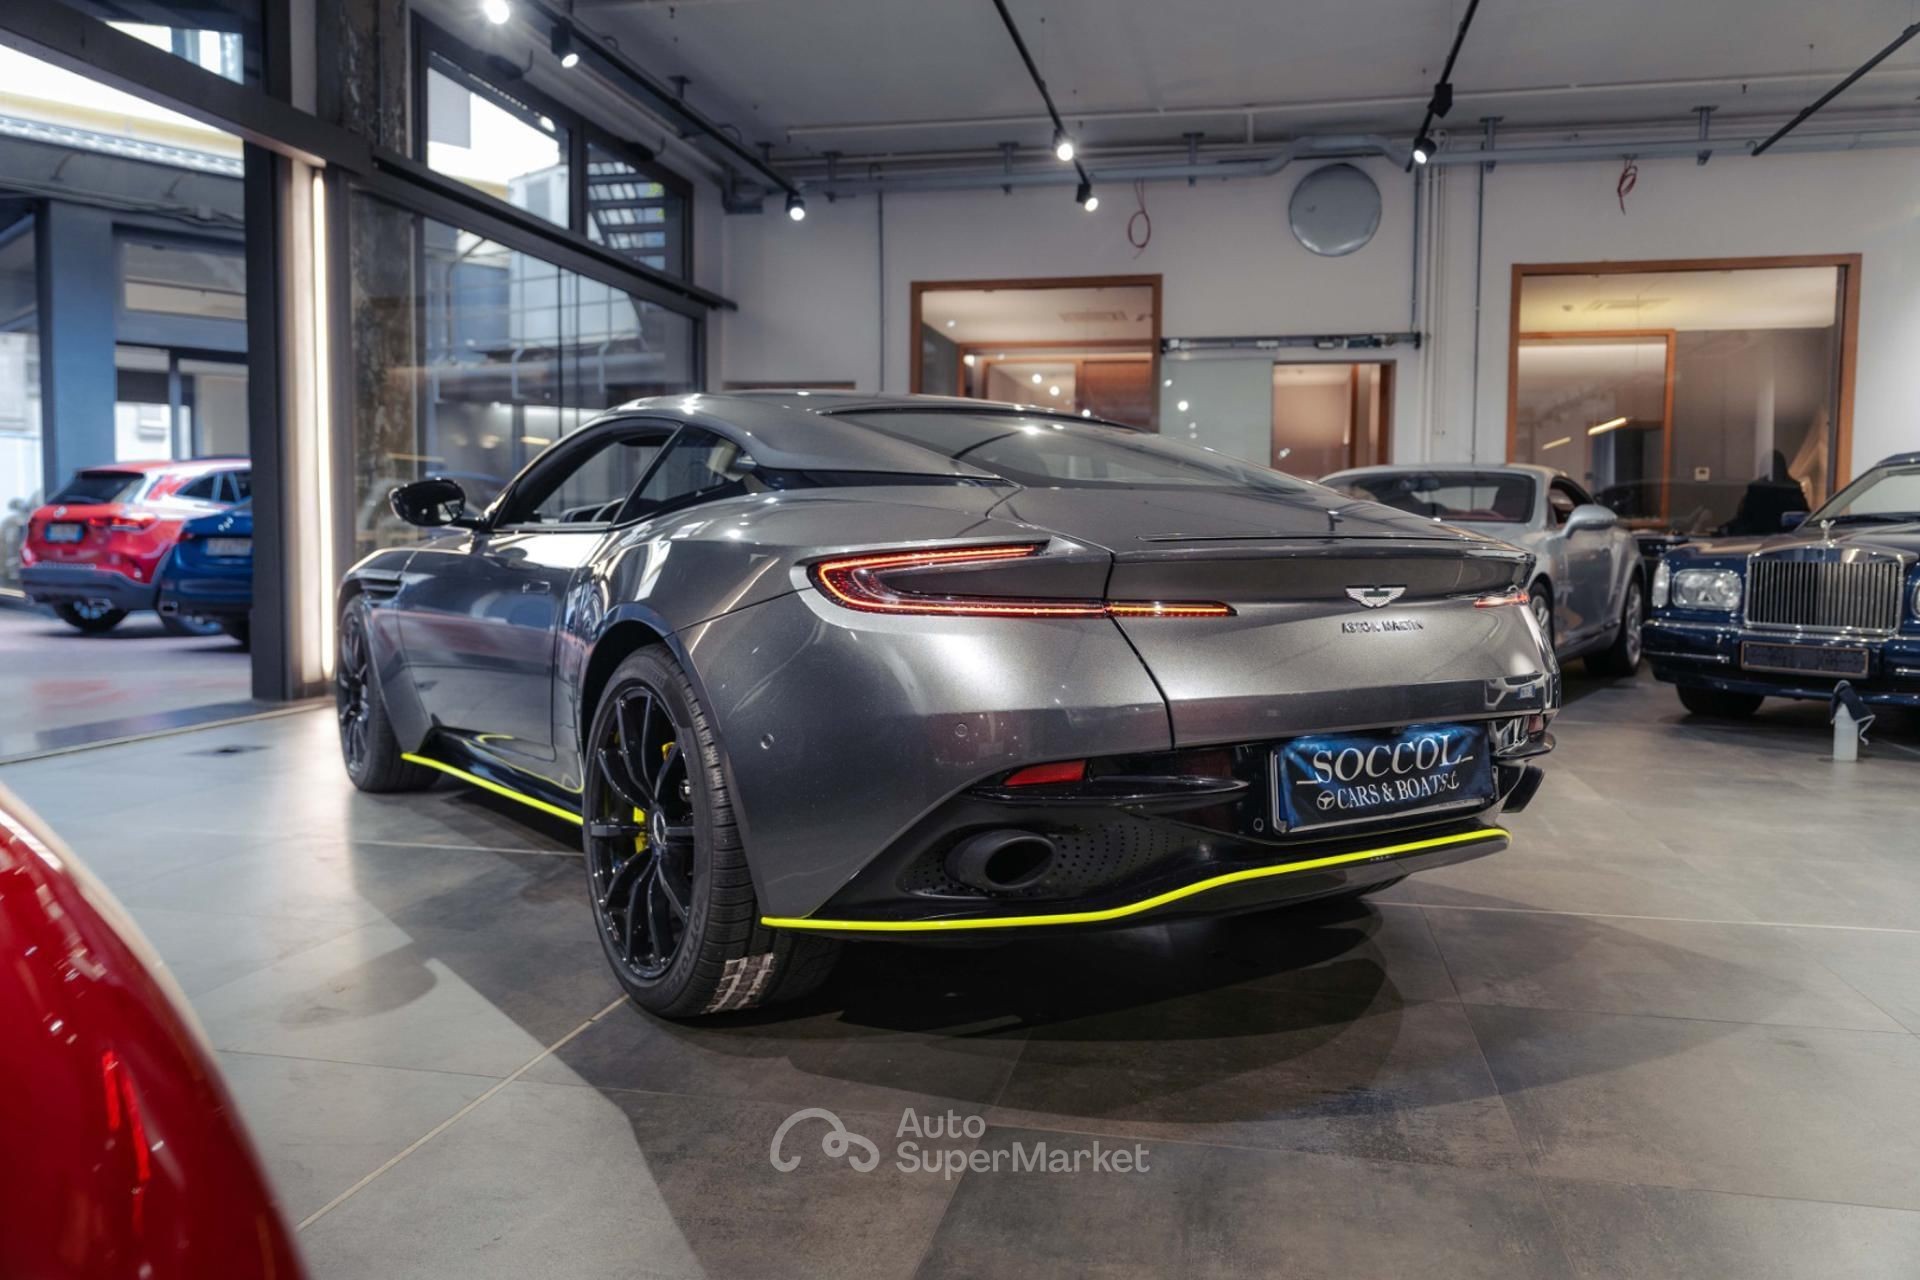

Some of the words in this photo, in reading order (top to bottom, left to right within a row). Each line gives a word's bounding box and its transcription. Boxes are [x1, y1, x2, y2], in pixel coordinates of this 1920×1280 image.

[1312, 735, 1463, 785] SOCCOL
[1336, 787, 1381, 810] CARS
[1381, 783, 1395, 801] &
[1398, 772, 1450, 801] BOATS
